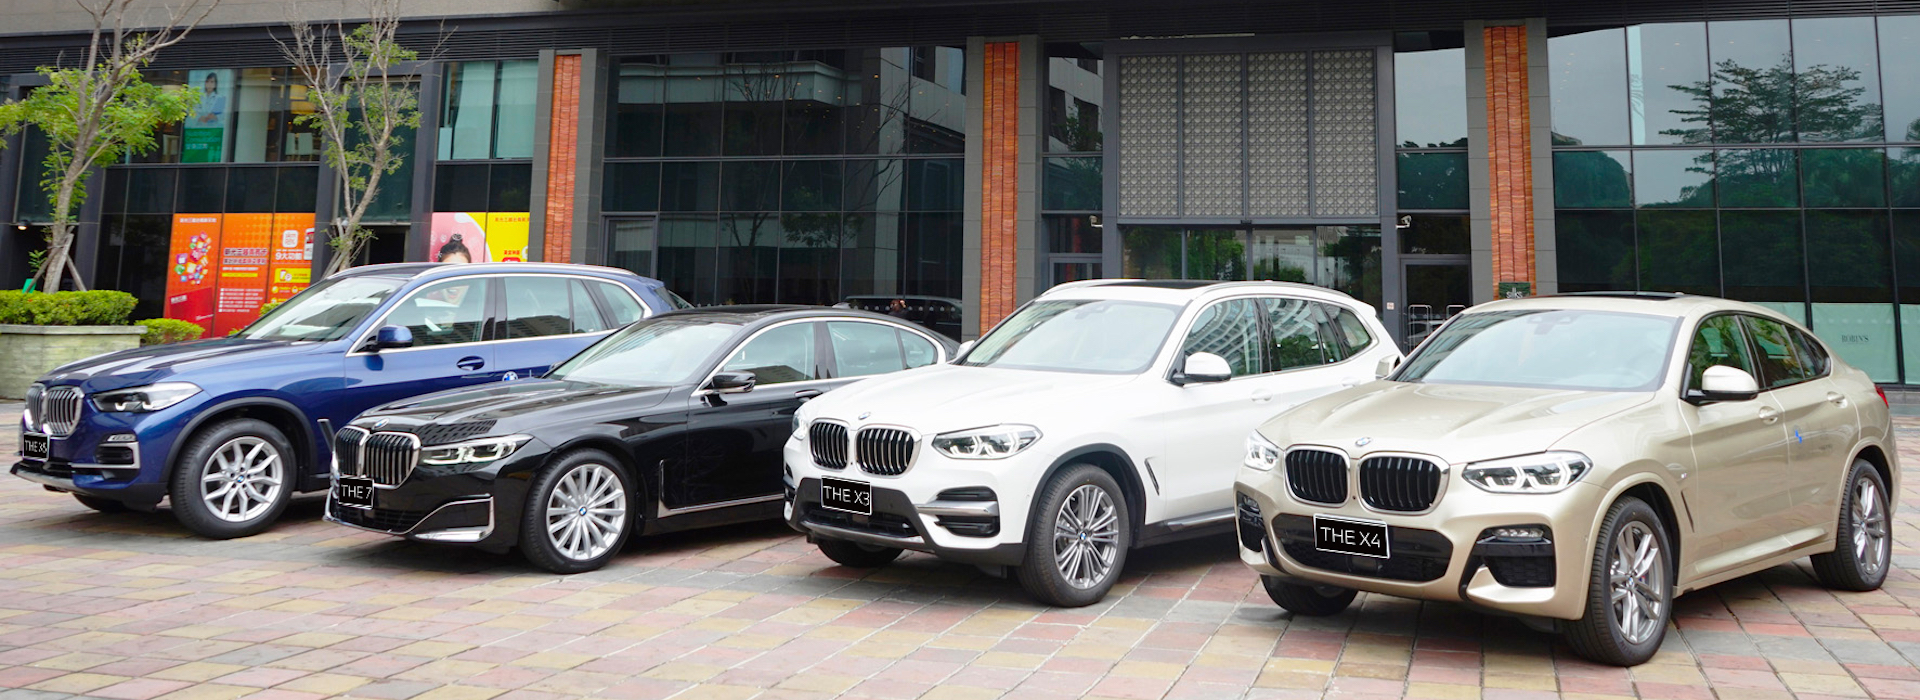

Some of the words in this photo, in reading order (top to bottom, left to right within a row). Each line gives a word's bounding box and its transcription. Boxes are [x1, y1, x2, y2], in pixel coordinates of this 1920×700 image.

[24, 440, 38, 453] THE
[341, 484, 364, 499] THE
[365, 486, 373, 500] 7
[823, 485, 851, 503] THE
[854, 490, 870, 507] X3
[1320, 526, 1357, 546] THE
[1359, 530, 1381, 549] X4
